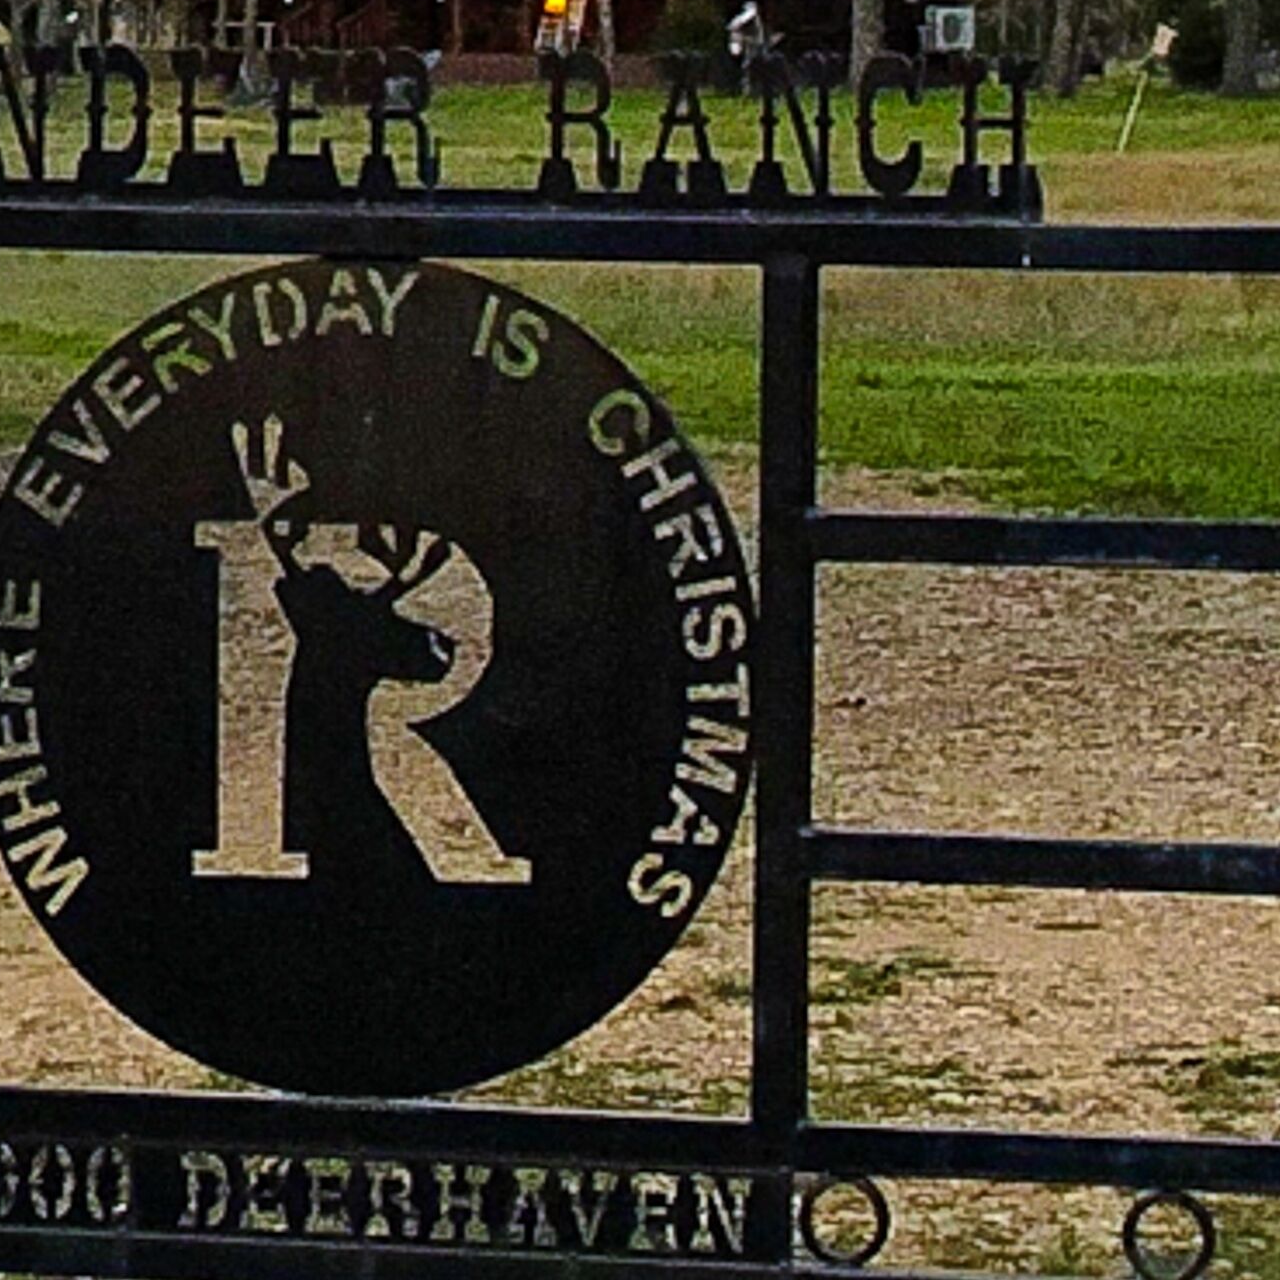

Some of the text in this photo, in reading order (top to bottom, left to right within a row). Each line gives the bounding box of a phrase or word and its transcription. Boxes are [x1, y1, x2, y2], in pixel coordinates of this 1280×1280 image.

[537, 50, 1043, 204] RANCH
[14, 268, 421, 527] EVERYDAY
[471, 294, 550, 378] IS
[588, 389, 750, 918] CHRISTMAS
[191, 518, 531, 883] R
[178, 1148, 753, 1253] DEERHAVEN
